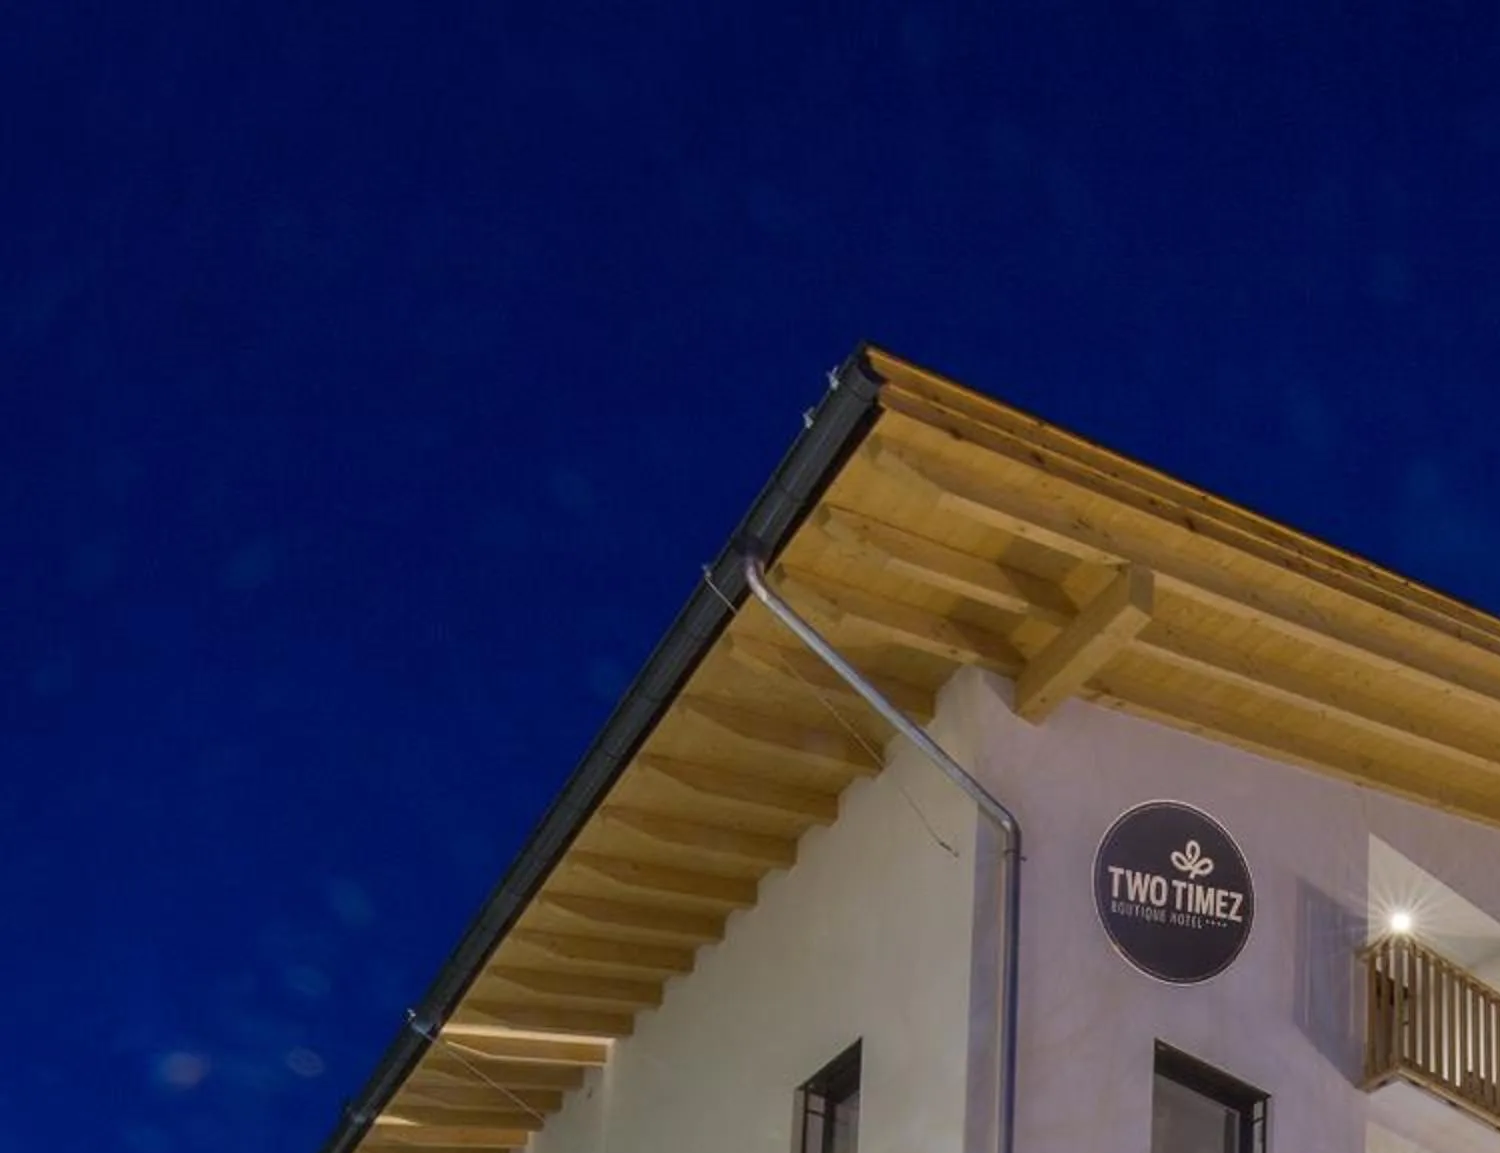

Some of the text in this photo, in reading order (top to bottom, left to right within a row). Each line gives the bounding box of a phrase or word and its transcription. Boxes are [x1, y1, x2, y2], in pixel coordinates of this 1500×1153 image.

[1107, 865, 1244, 923] TWO TIMEZ
[1111, 900, 1203, 929] BOUTIQUE HOTEL
